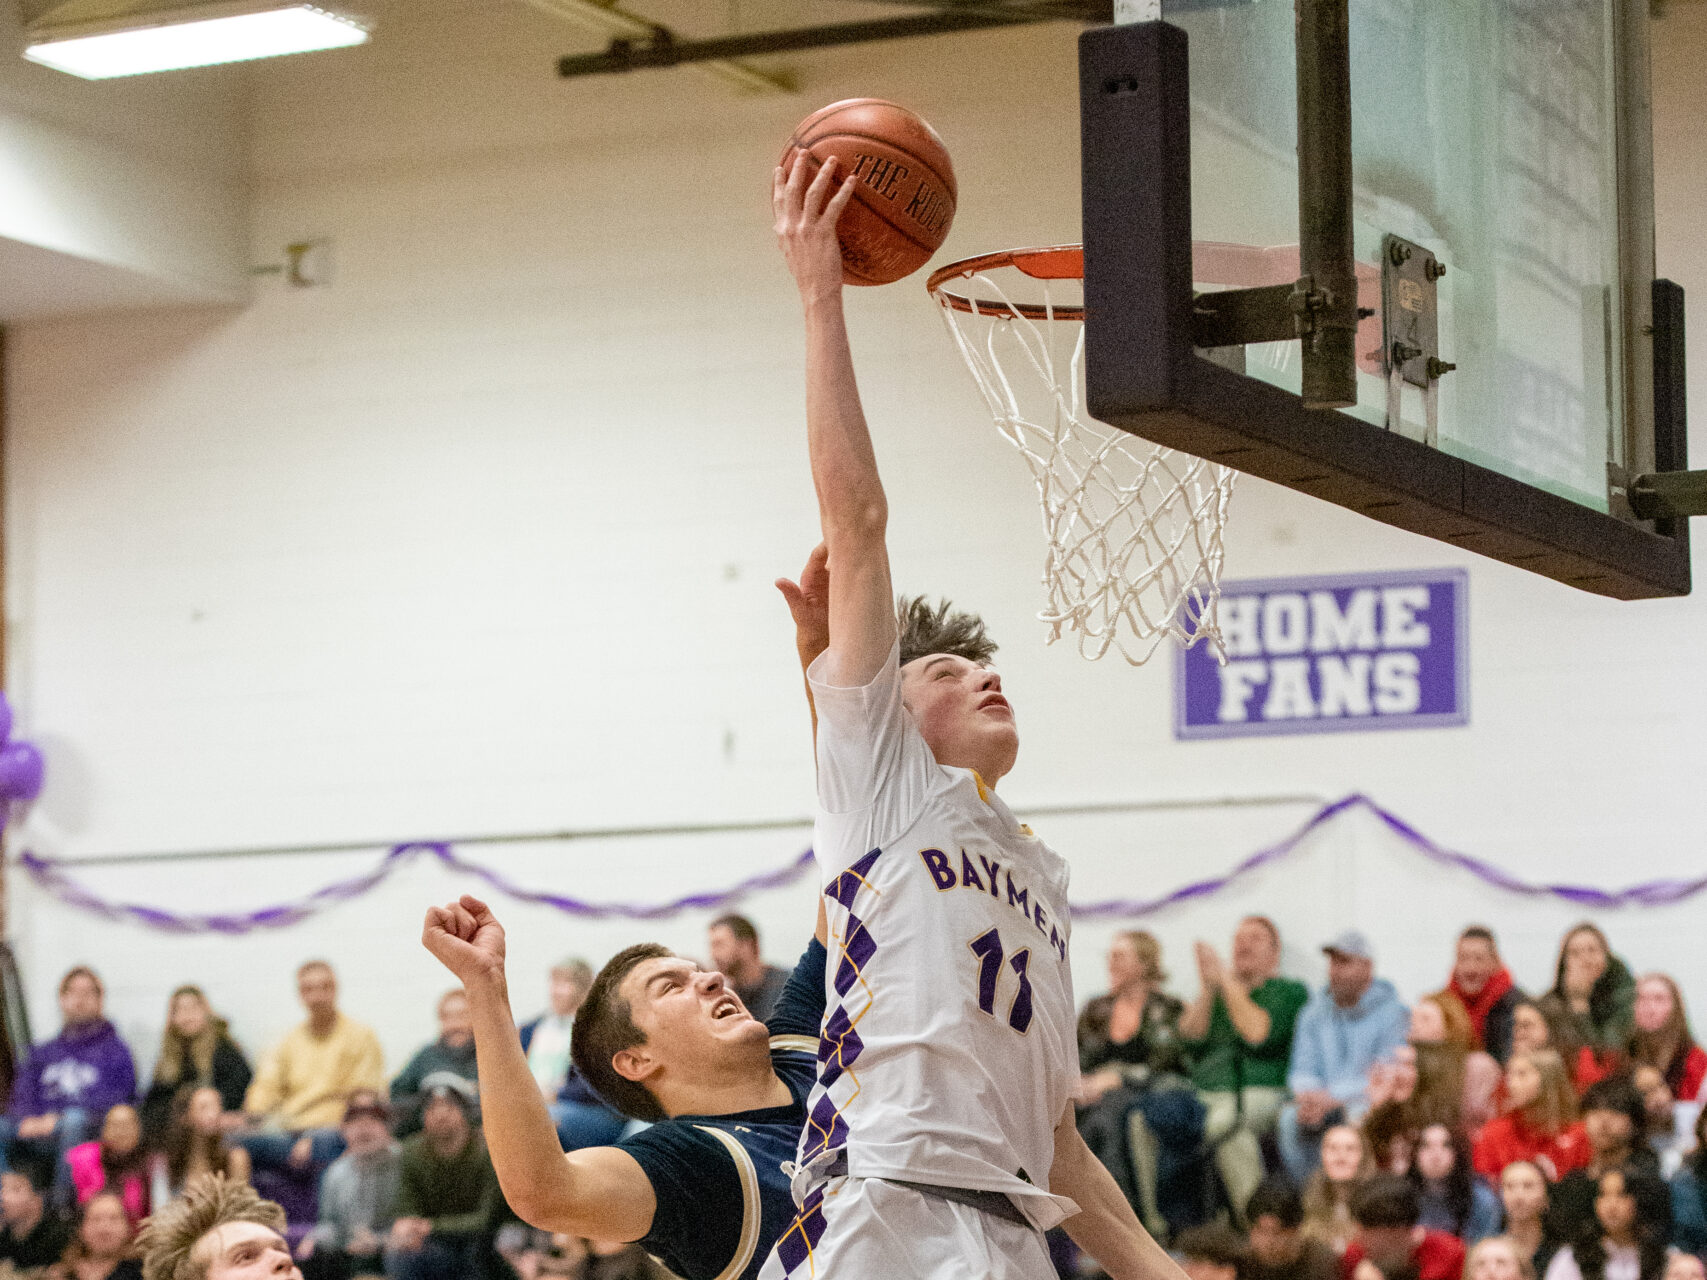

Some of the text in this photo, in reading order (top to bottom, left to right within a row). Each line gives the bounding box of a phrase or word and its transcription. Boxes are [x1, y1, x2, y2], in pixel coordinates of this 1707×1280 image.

[853, 153, 909, 201] THE
[1209, 585, 1431, 657] HOME
[1217, 651, 1421, 722] FANS
[918, 847, 1066, 963] BAYMEN
[967, 925, 1034, 1037] 11
